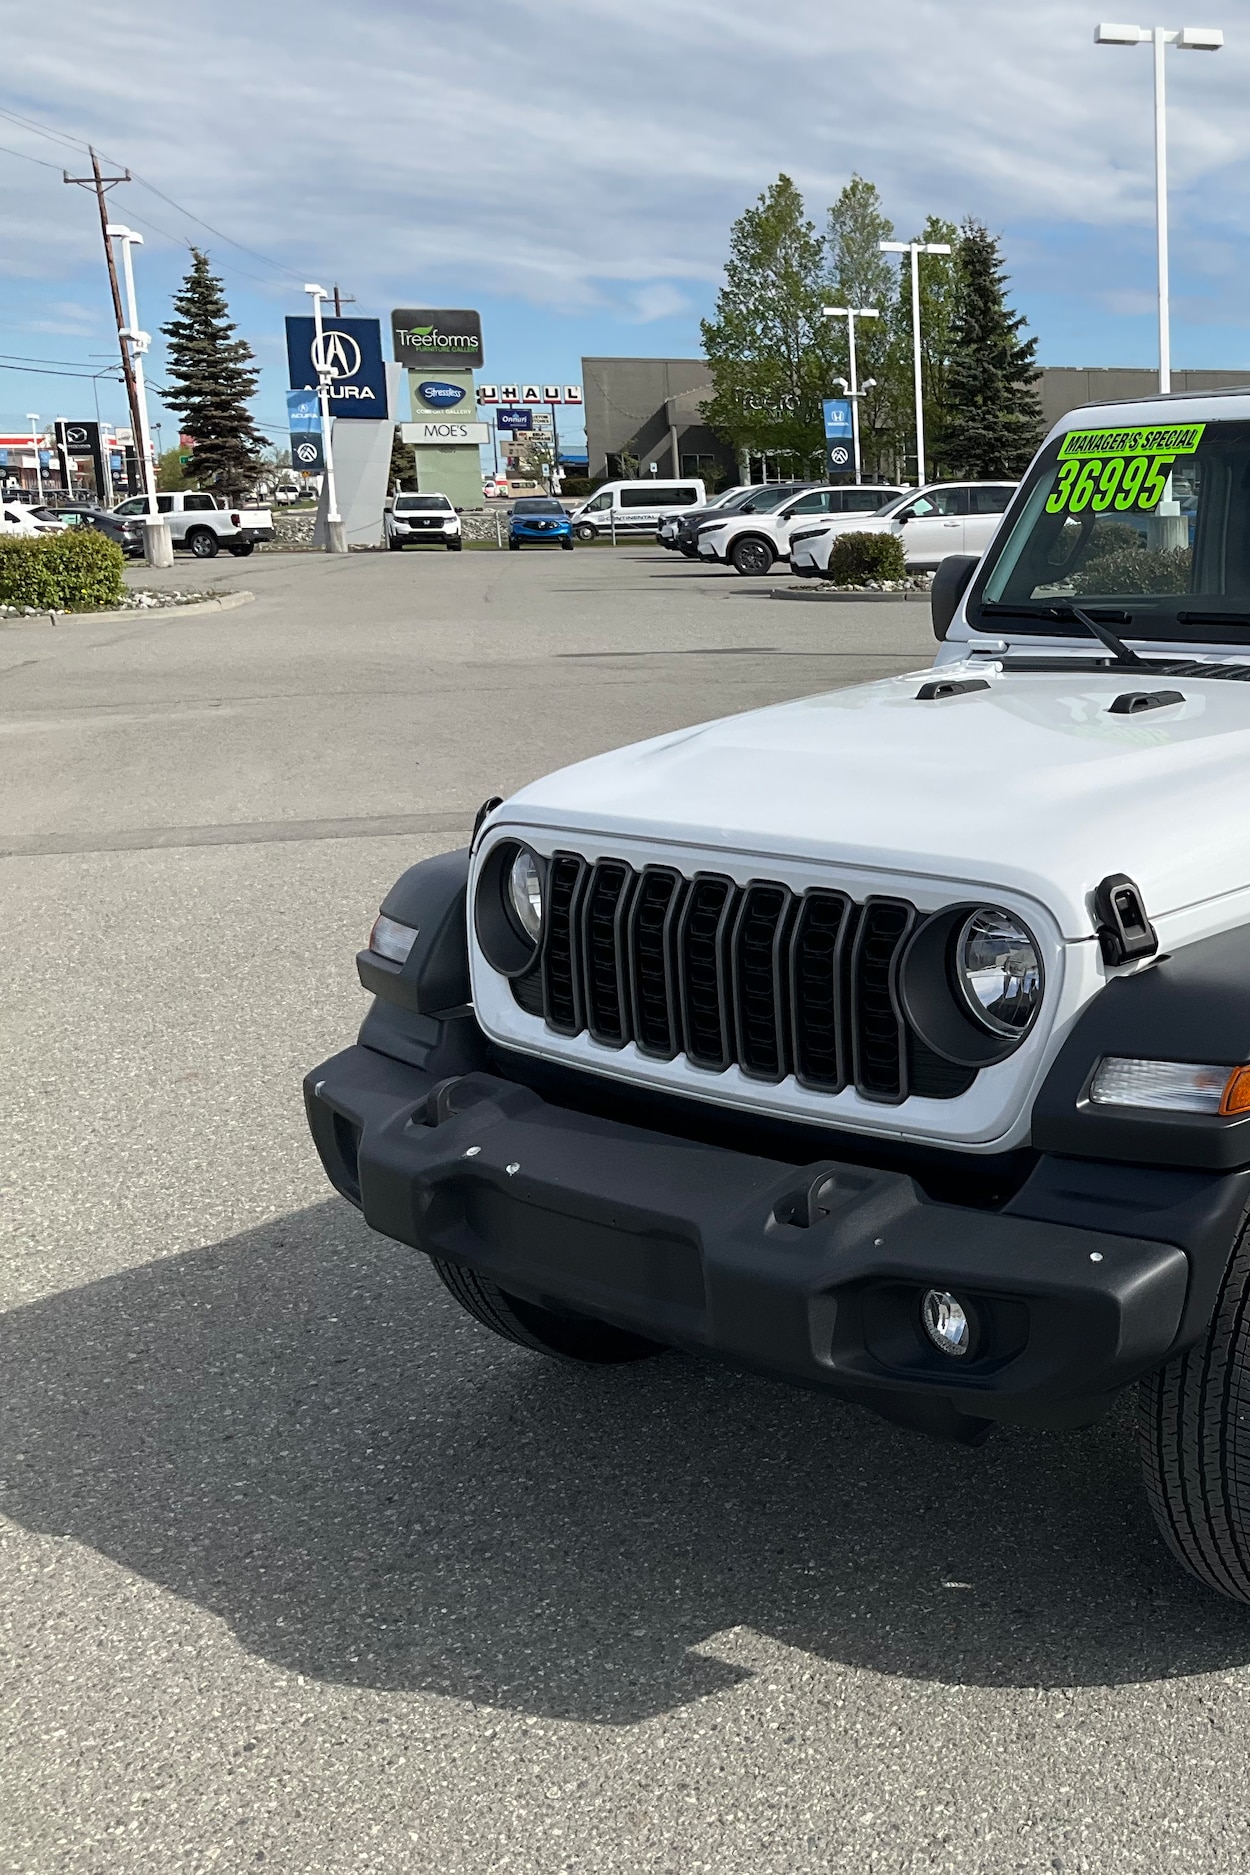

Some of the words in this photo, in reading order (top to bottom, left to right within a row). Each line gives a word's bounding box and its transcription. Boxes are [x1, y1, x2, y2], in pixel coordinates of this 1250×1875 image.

[396, 329, 479, 348] Treeforms
[424, 387, 463, 398] Stressless
[424, 424, 468, 437] MOE'S
[1064, 433, 1142, 454] MANAGER'S
[1141, 429, 1199, 449] SPECIAL
[1045, 455, 1176, 513] 36995
[605, 513, 657, 521] CNTINENTAL
